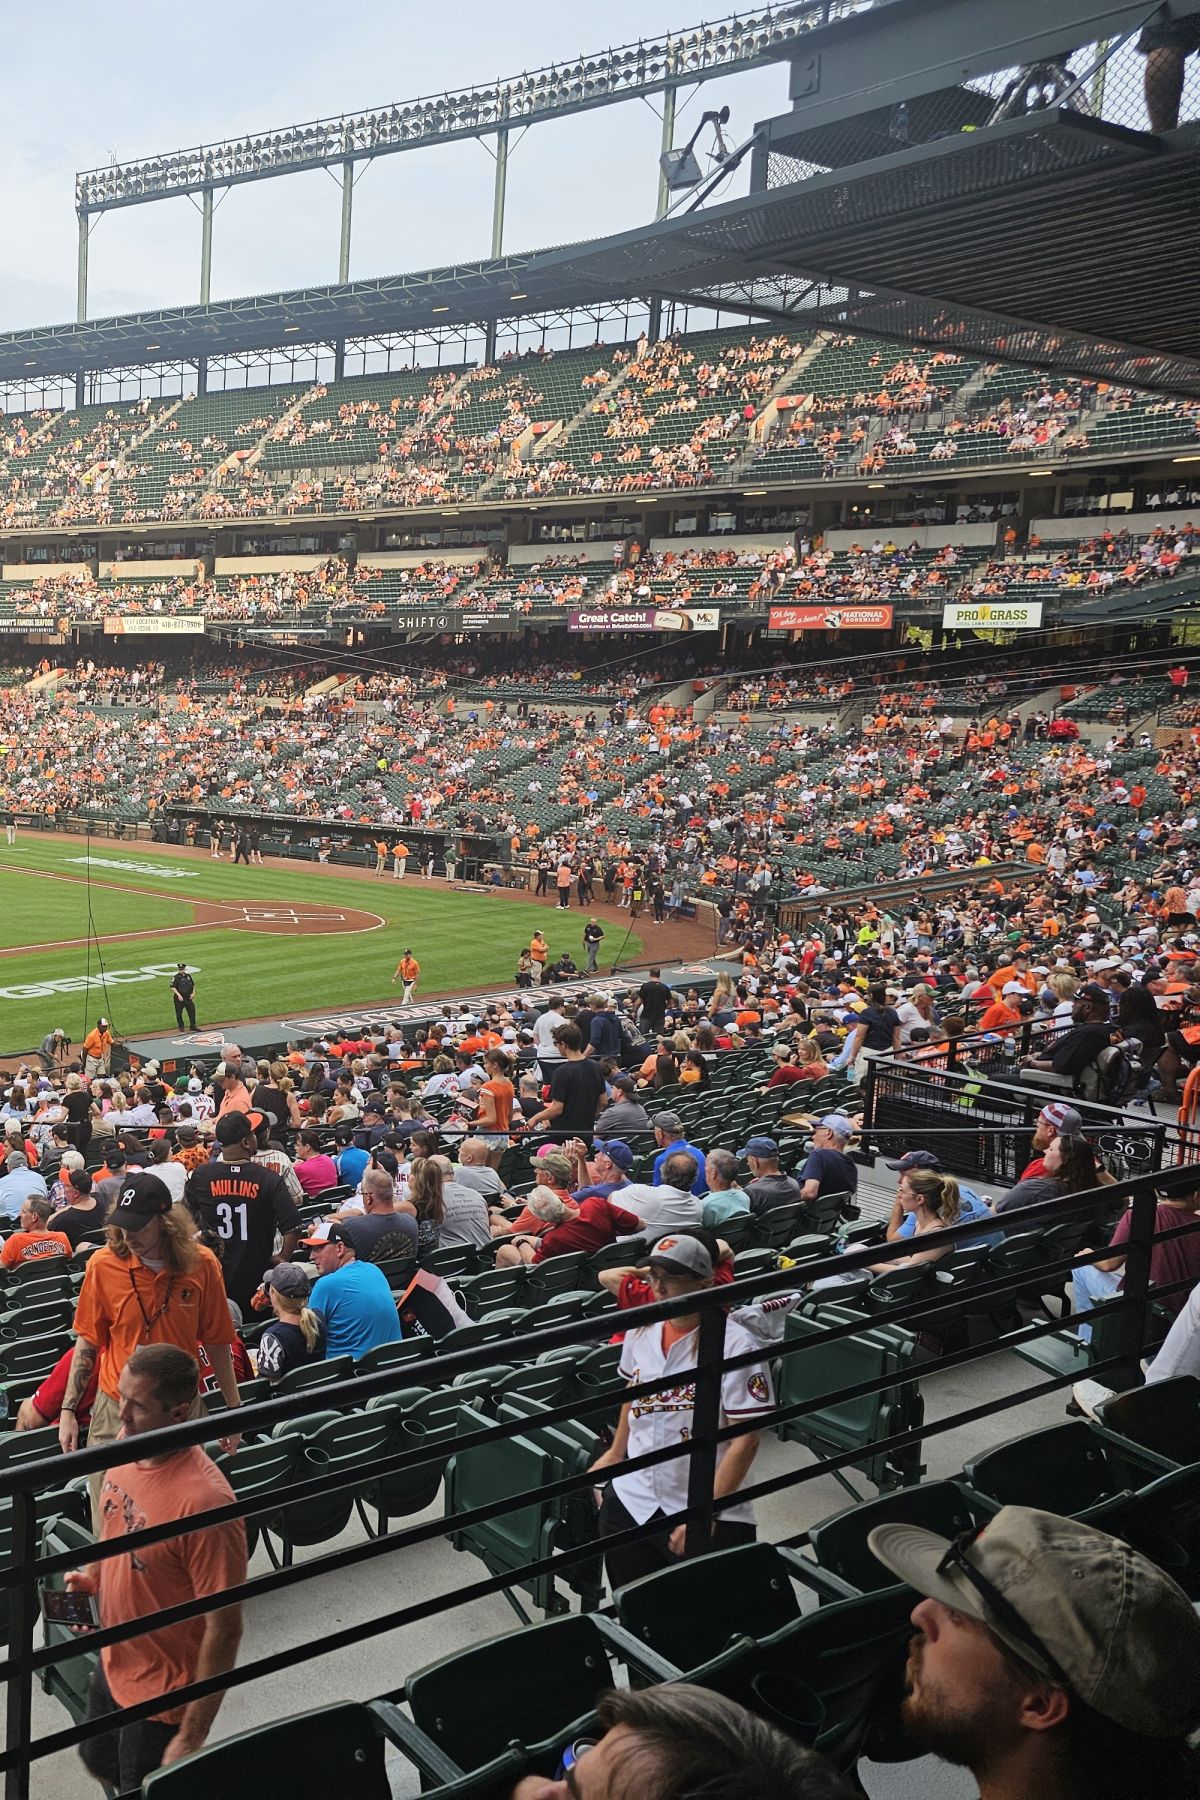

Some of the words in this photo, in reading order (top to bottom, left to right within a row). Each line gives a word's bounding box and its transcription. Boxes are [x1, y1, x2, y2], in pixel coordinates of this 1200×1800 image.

[398, 617, 436, 628] SHIFT
[579, 613, 608, 623] Great
[610, 612, 646, 623] Catch!
[956, 610, 979, 621] PRO
[989, 609, 1028, 621] GRASS
[298, 1004, 441, 1031] WELCOME
[196, 1105, 214, 1120] 74
[1114, 1140, 1135, 1156] 56
[210, 1179, 260, 1199] MULLINS
[120, 1189, 136, 1207] B
[216, 1202, 248, 1241] 31
[21, 1240, 66, 1258] HENDERSON
